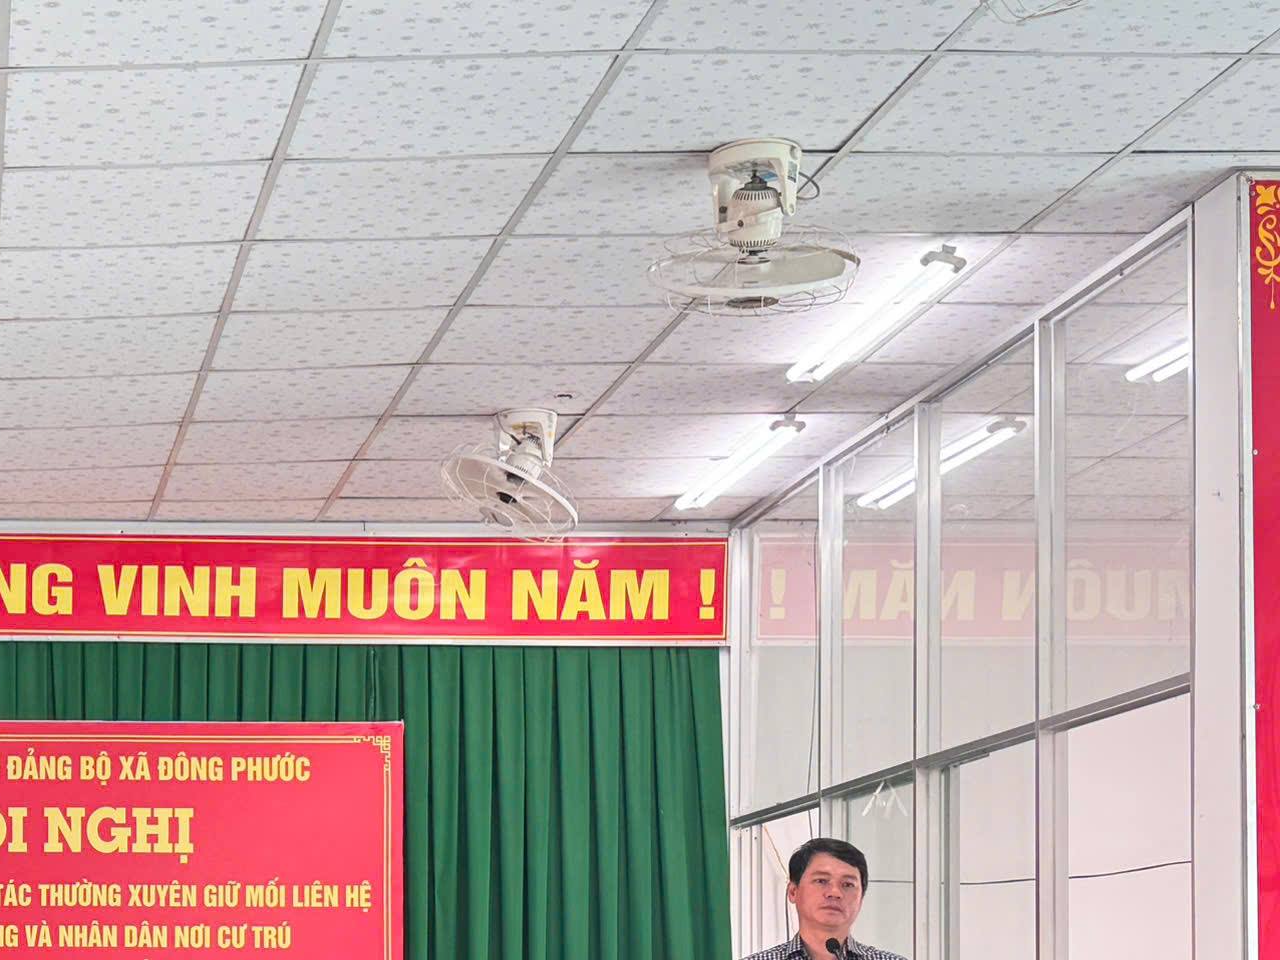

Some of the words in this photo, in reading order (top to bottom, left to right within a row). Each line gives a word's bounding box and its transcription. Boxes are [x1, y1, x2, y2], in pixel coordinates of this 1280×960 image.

[97, 565, 257, 618] VINH
[282, 557, 487, 621] MUÔN
[511, 558, 670, 621] NĂM
[698, 568, 716, 620] !
[6, 747, 72, 781] ĐẢNG
[80, 750, 112, 786] BỘ
[119, 751, 151, 781] XÃ
[157, 751, 224, 782] ĐÔNG
[231, 751, 311, 782] PHƯỚC
[43, 806, 194, 864] NGHỊ
[38, 878, 122, 907] THƯỜNG
[127, 879, 197, 908] XUYÊN
[203, 880, 242, 908] GIỮ
[245, 876, 286, 908] MỐI
[292, 880, 339, 908] LIÊN
[345, 879, 372, 913] HỆ
[24, 919, 53, 948] VÀ
[58, 920, 118, 948] NHÂN
[124, 920, 168, 948] DÂN
[174, 923, 211, 949] NƠI
[217, 923, 248, 949] CƯ
[251, 920, 291, 949] TRÚ
